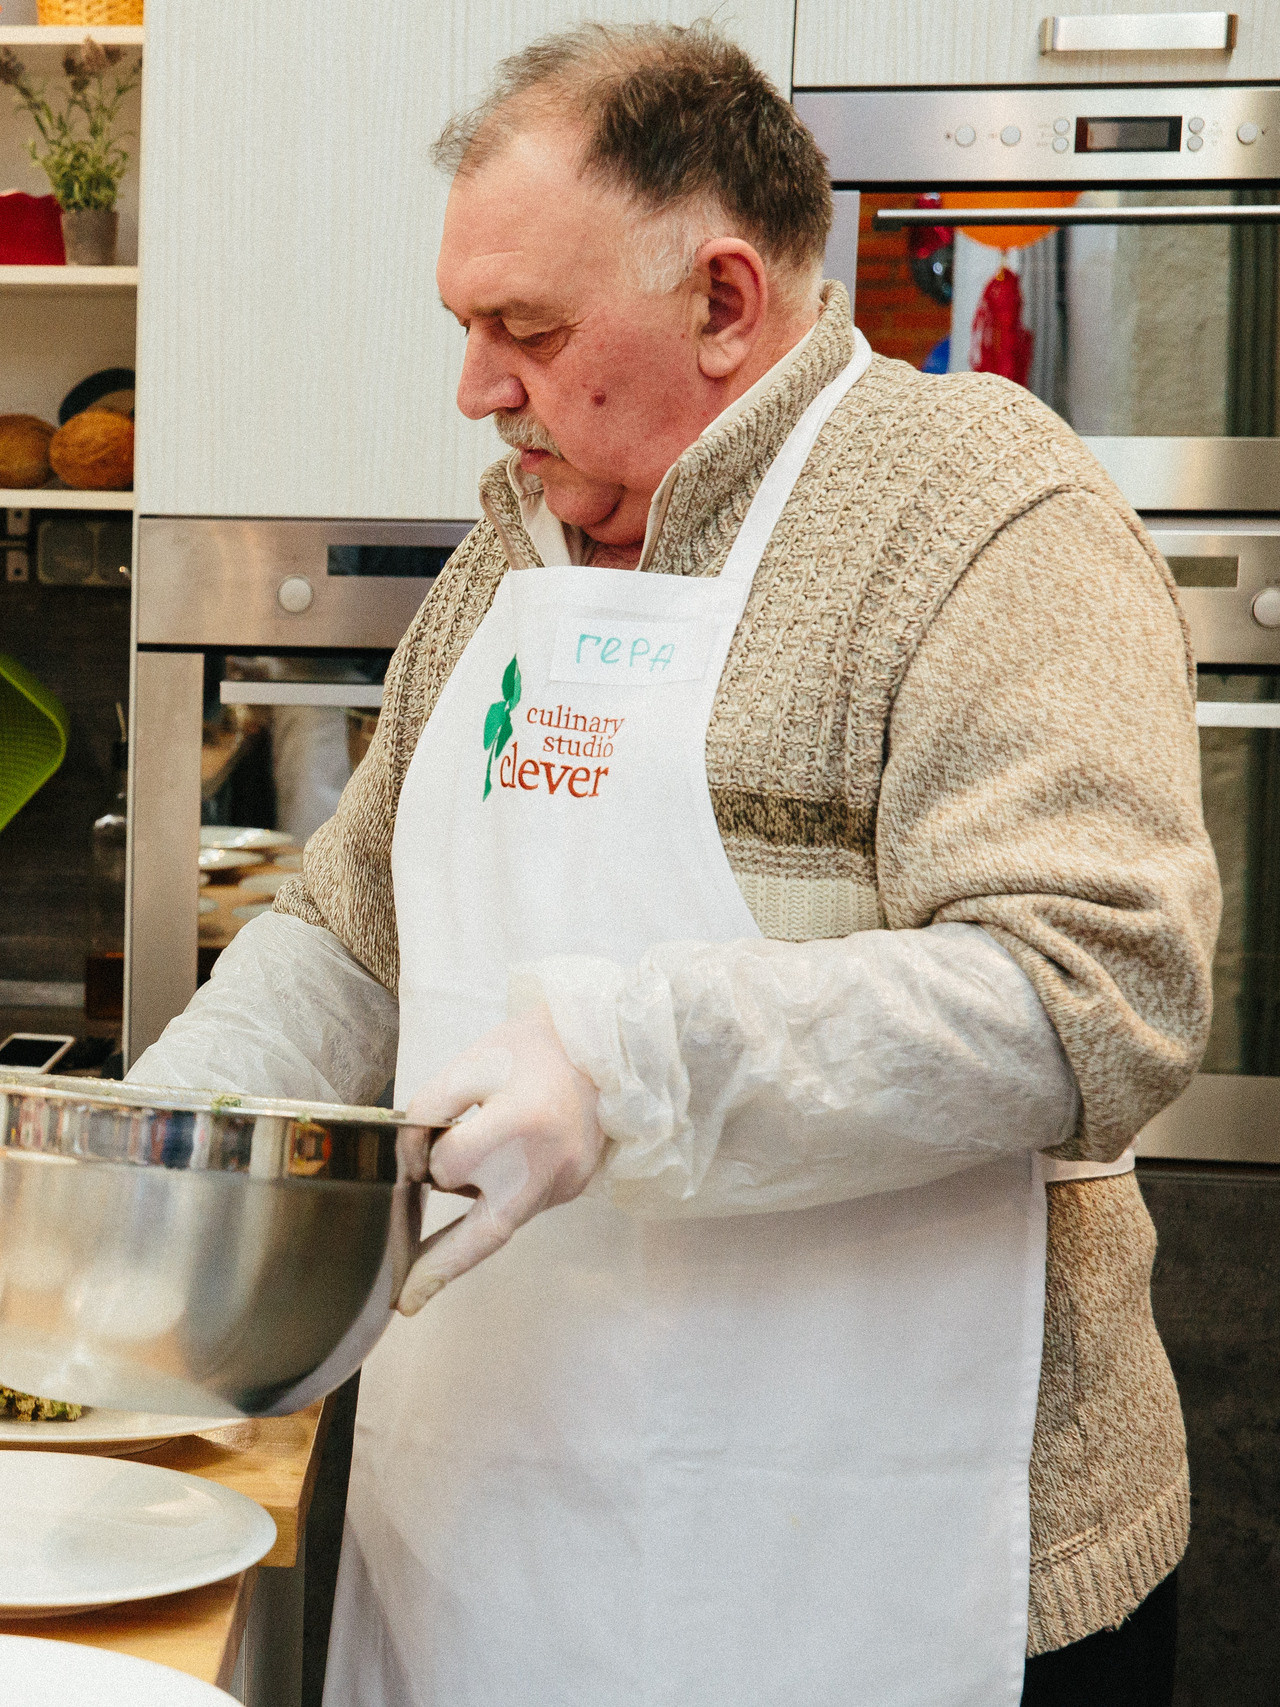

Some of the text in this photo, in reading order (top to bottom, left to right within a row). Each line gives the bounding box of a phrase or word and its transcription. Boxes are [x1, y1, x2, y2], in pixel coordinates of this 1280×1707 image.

[526, 704, 625, 740] culinary
[542, 734, 614, 759] studio
[499, 741, 610, 799] clever
